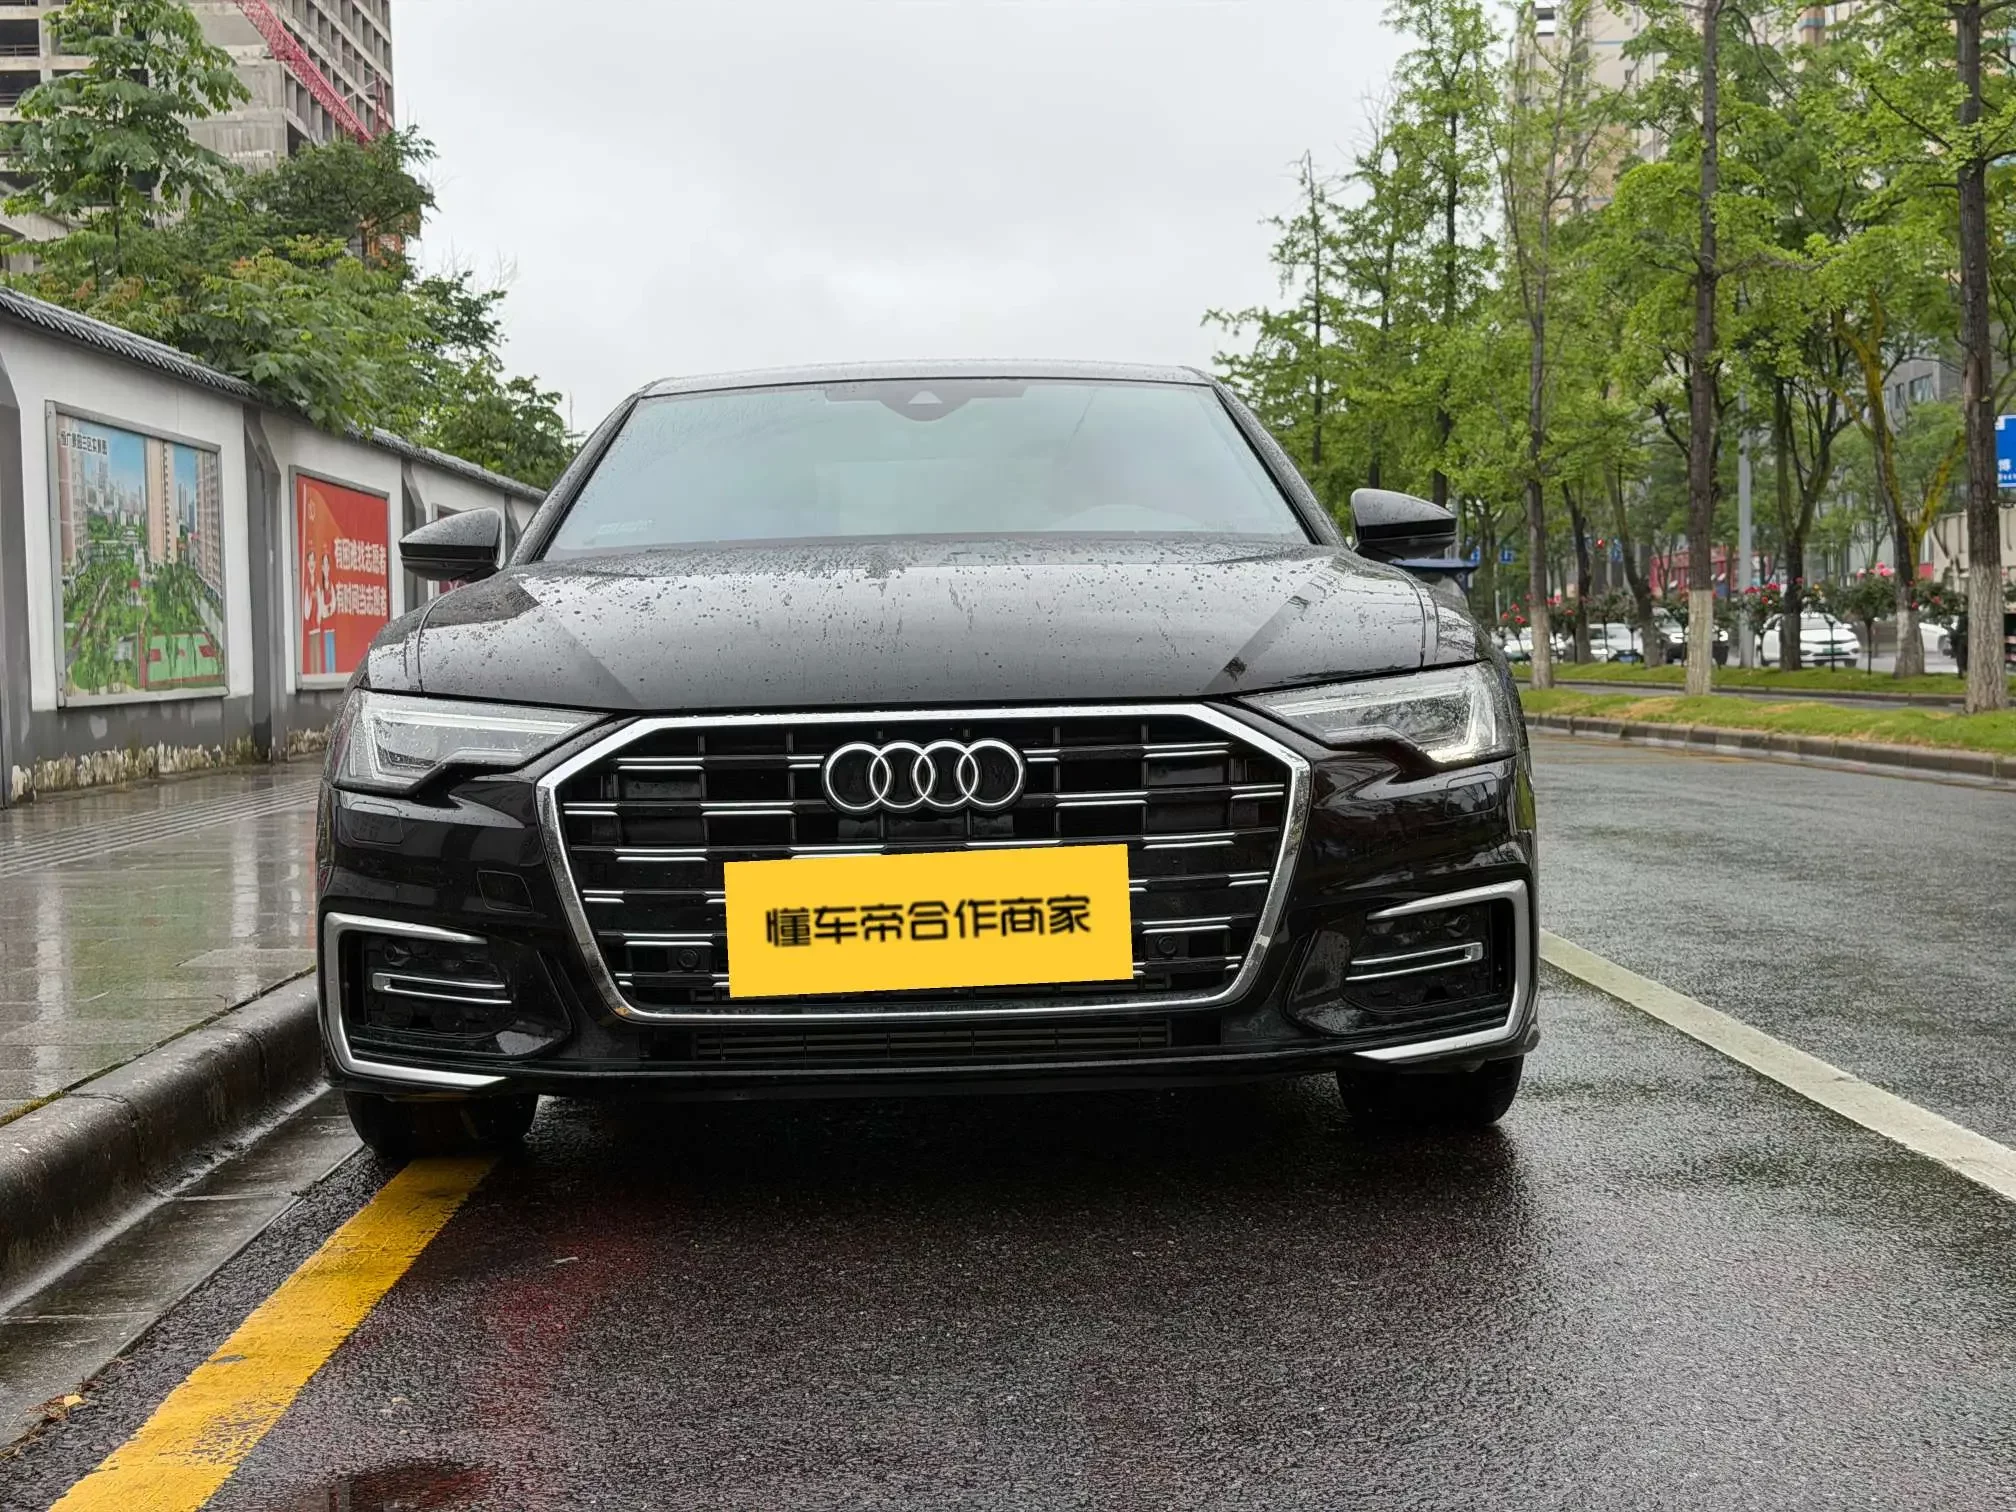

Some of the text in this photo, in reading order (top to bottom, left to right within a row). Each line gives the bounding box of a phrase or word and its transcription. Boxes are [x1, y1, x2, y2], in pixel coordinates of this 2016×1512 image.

[334, 537, 387, 575] 有困难找志愿者
[336, 582, 387, 616] 有时间当志愿者
